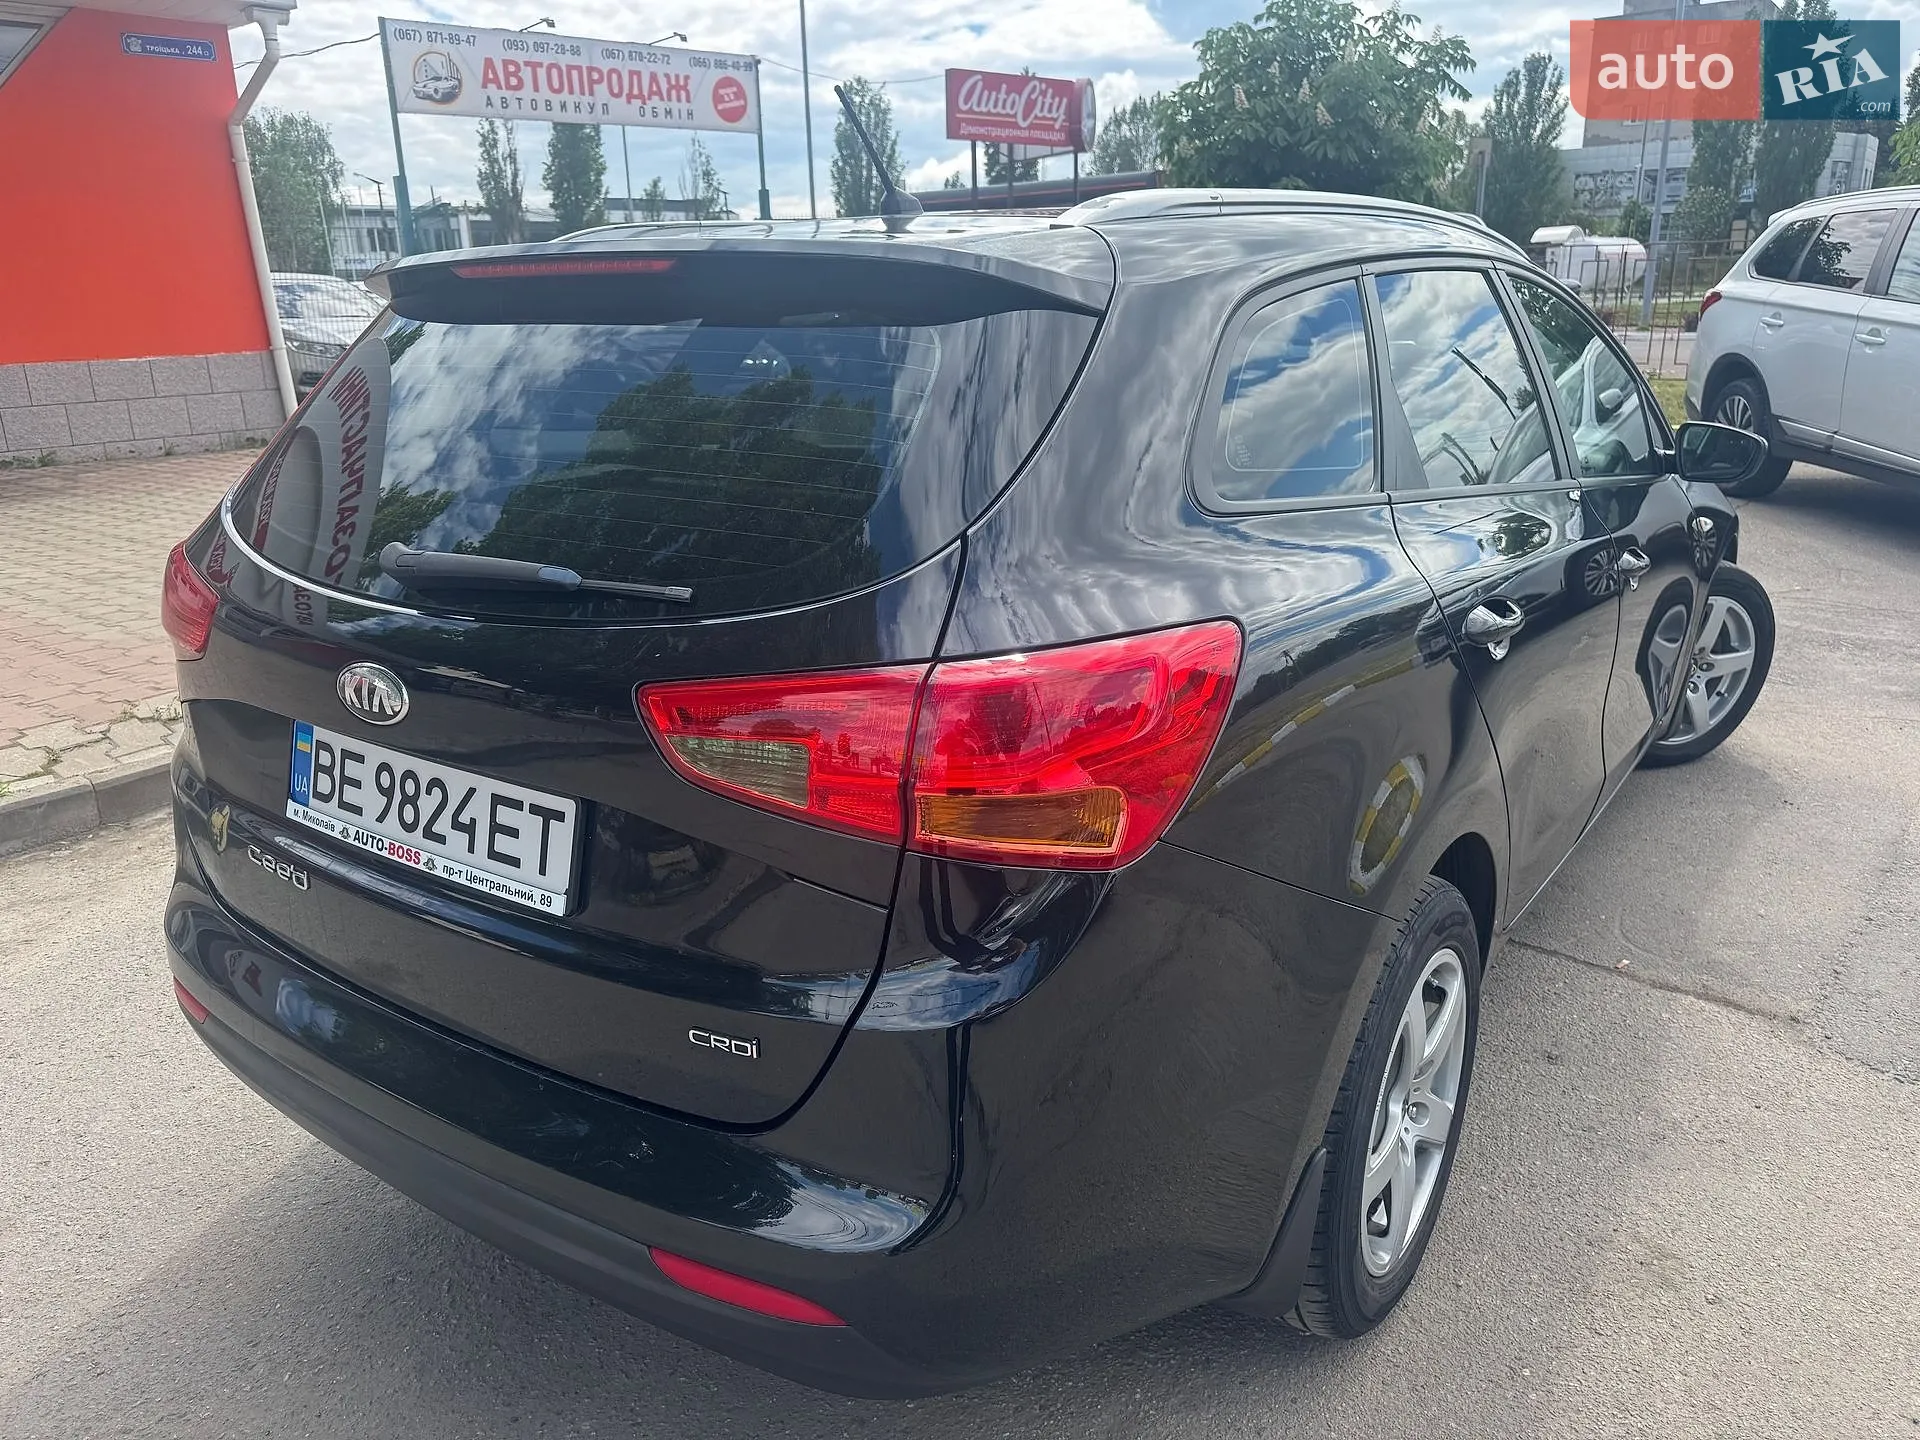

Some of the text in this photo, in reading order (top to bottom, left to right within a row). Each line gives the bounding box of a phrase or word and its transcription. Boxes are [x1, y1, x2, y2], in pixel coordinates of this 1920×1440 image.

[393, 27, 478, 48] (067) 871-89-47
[501, 38, 530, 54] (093)
[600, 47, 626, 63] (067)
[480, 56, 693, 105] АВТОПРОДАЖ
[485, 94, 696, 122] АВТОВИКУП ОБМІН
[344, 674, 395, 716] KIA
[294, 772, 309, 795] UA
[312, 738, 566, 877] BE 9824 ET
[302, 807, 336, 834] Миколаїв
[352, 828, 422, 866] AUTO-BOSS
[441, 863, 464, 880] пр-т
[464, 866, 538, 907] Центральний,
[539, 893, 554, 909] 89
[688, 1029, 758, 1060] CRDi
